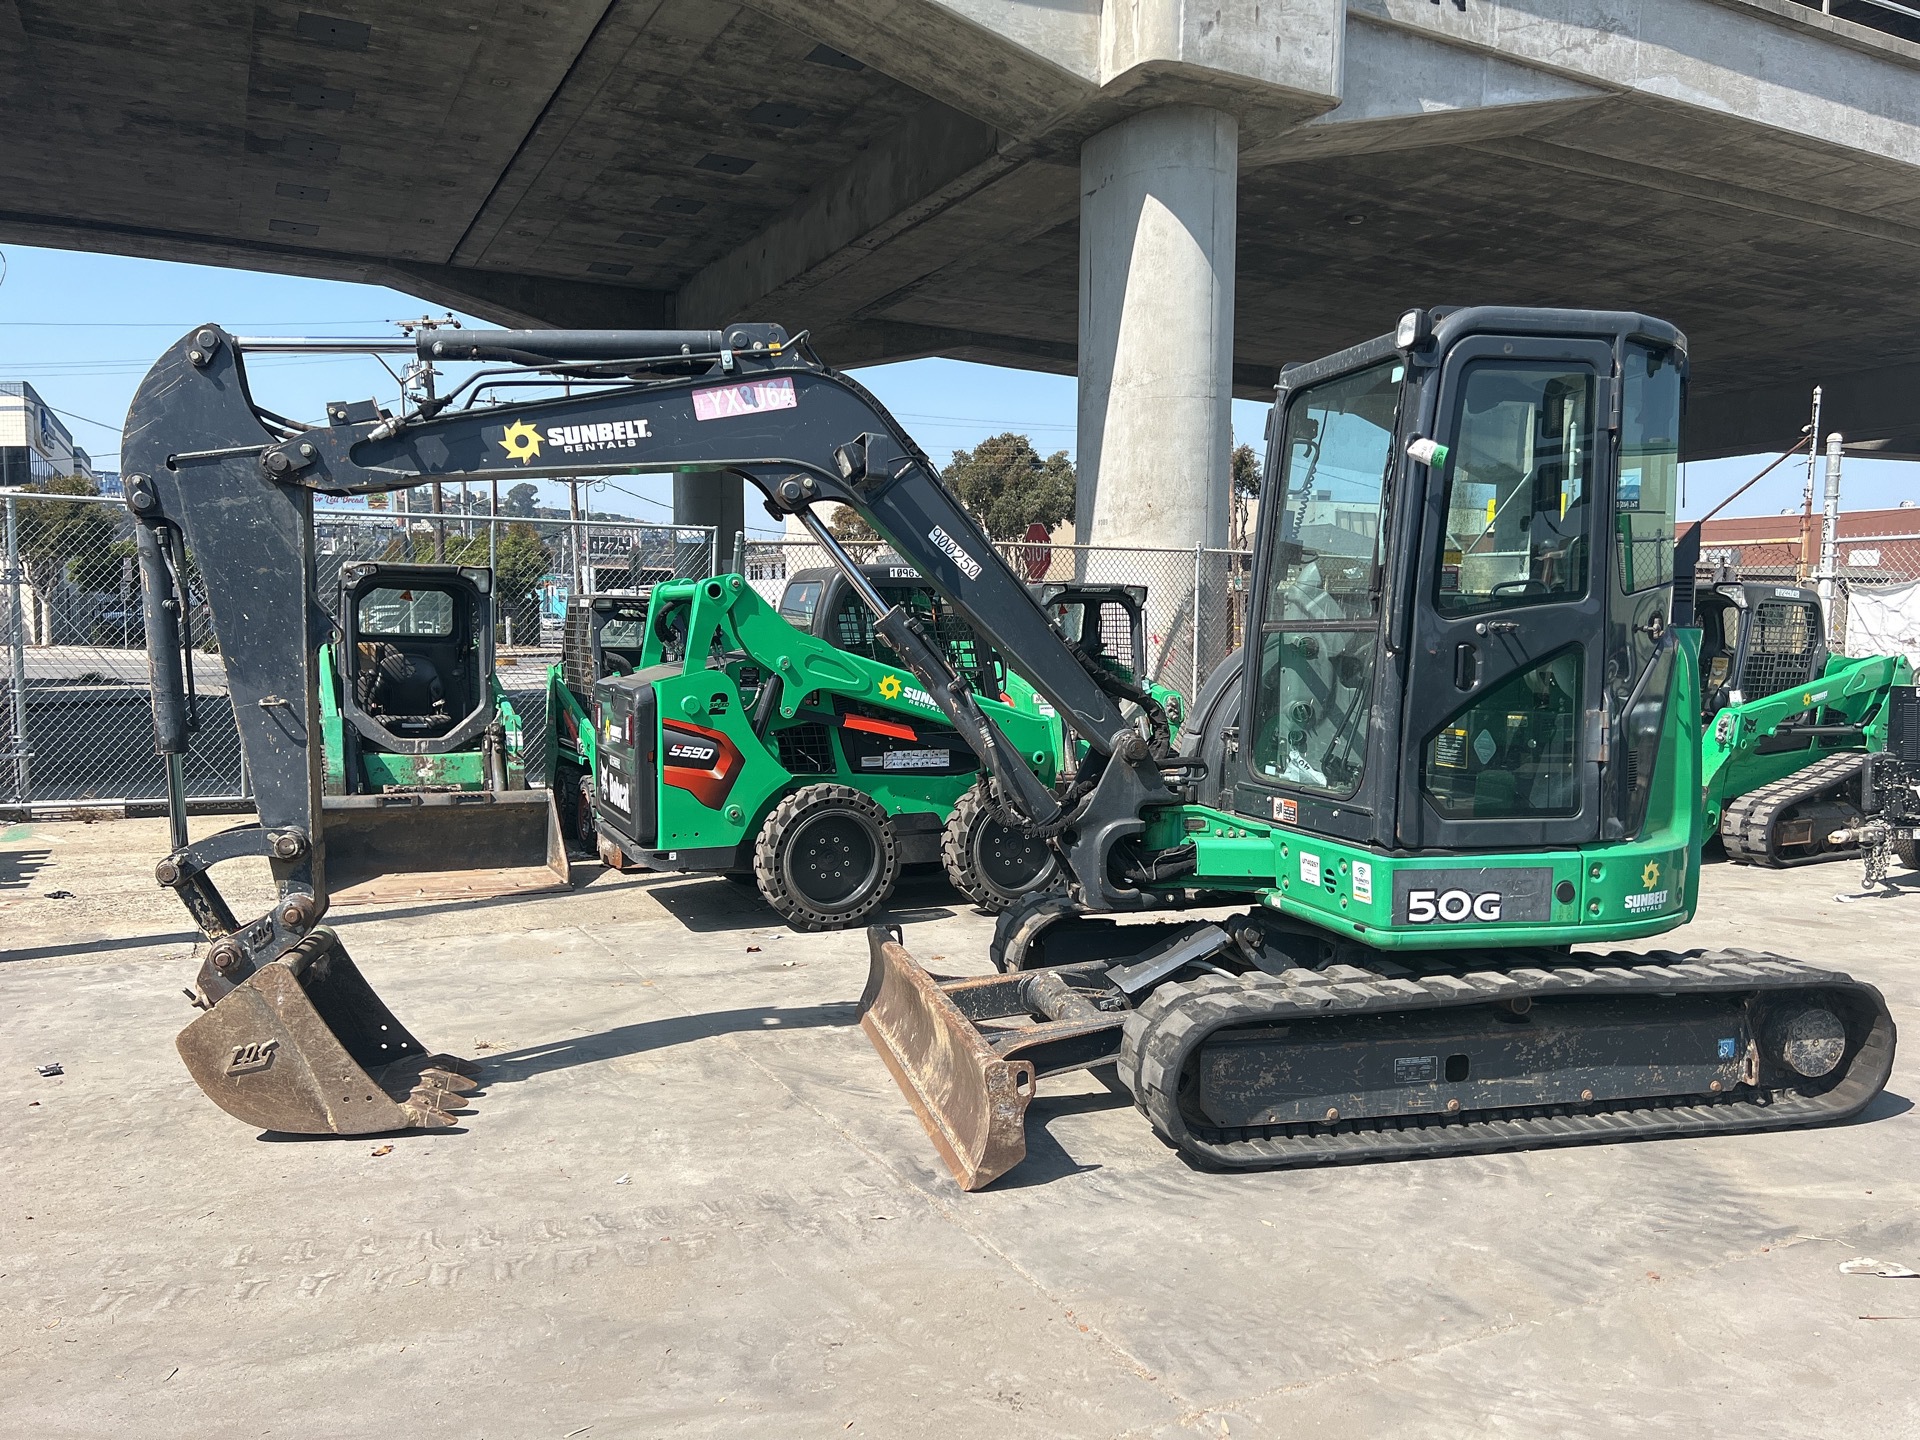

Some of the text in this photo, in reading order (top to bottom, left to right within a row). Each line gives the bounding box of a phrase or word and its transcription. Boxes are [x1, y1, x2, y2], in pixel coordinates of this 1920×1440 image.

[547, 419, 648, 447] SUNBELT
[563, 439, 637, 453] RENTALS
[933, 528, 981, 577] 900250
[1026, 540, 1050, 562] STOP
[708, 692, 728, 716] 2
[908, 700, 944, 714] RENTAL
[668, 744, 714, 760] S590
[1408, 888, 1502, 922] 50G
[1624, 889, 1668, 908] SUNBELT
[1630, 904, 1662, 914] RENTALS
